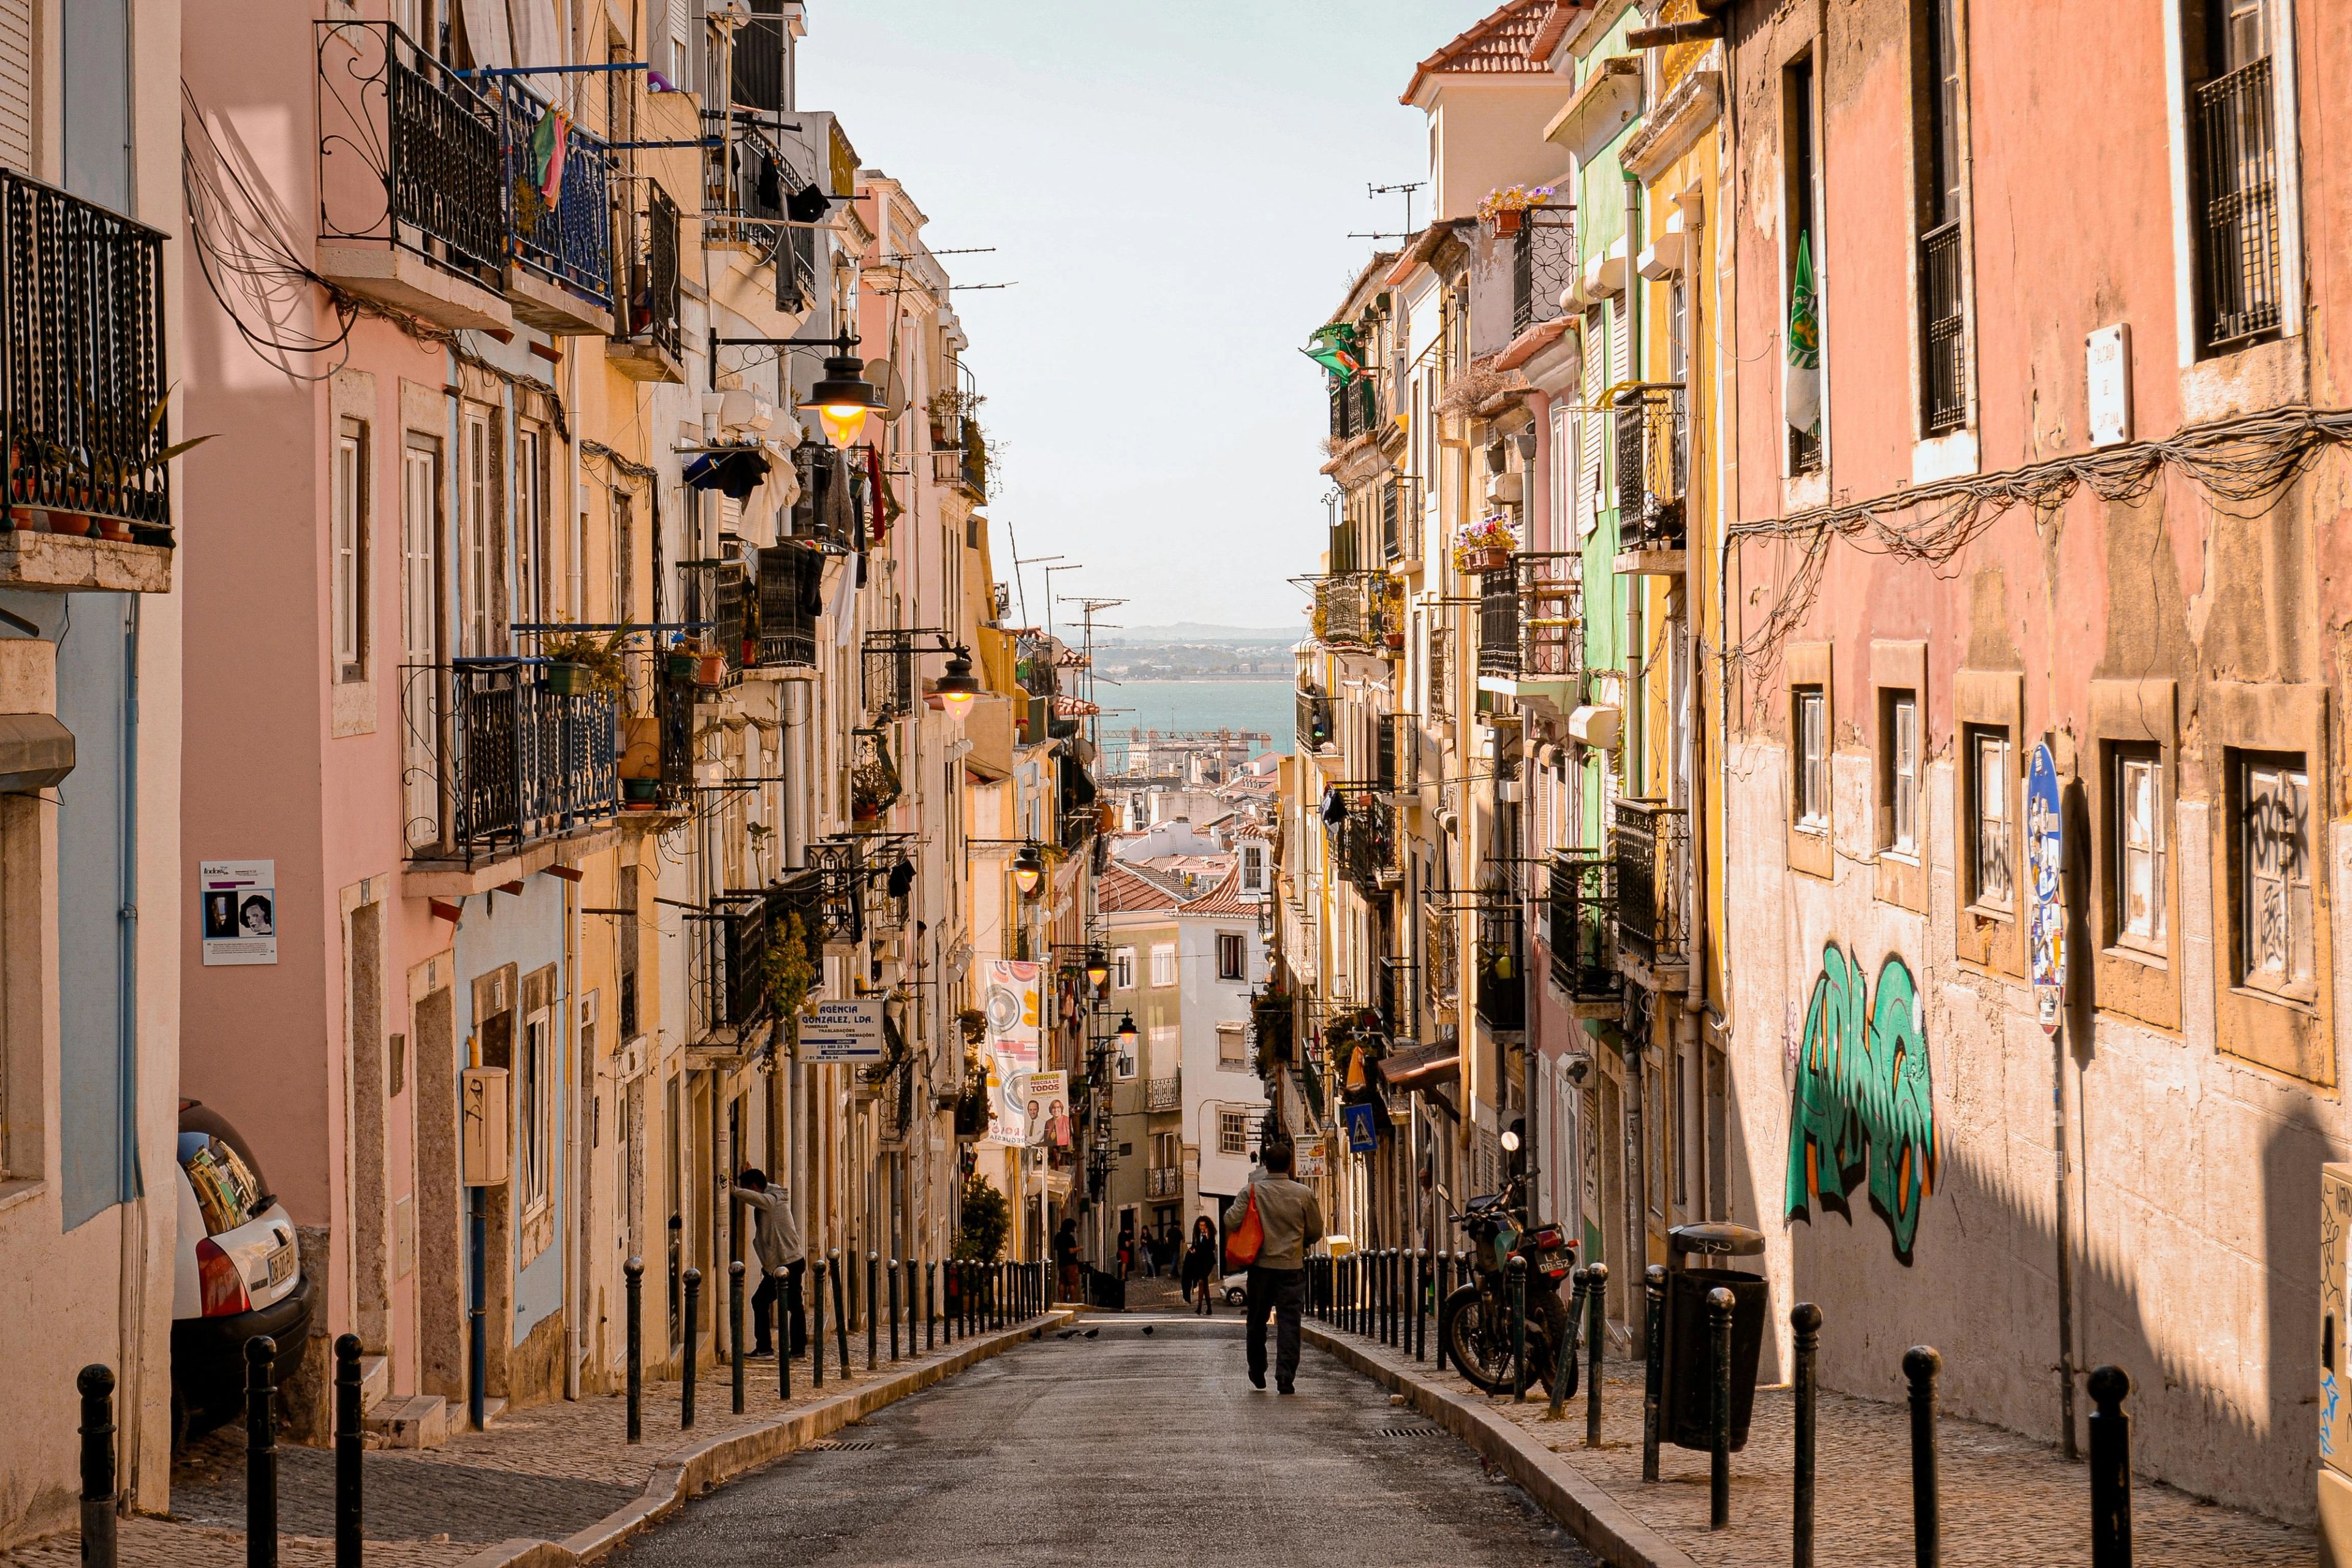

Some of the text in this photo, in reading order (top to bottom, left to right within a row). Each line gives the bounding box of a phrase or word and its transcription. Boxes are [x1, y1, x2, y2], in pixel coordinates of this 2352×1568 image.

[820, 1005, 858, 1014] AGÊNCIA
[1545, 1251, 1559, 1262] LX
[1540, 1259, 1570, 1273] 08-52
